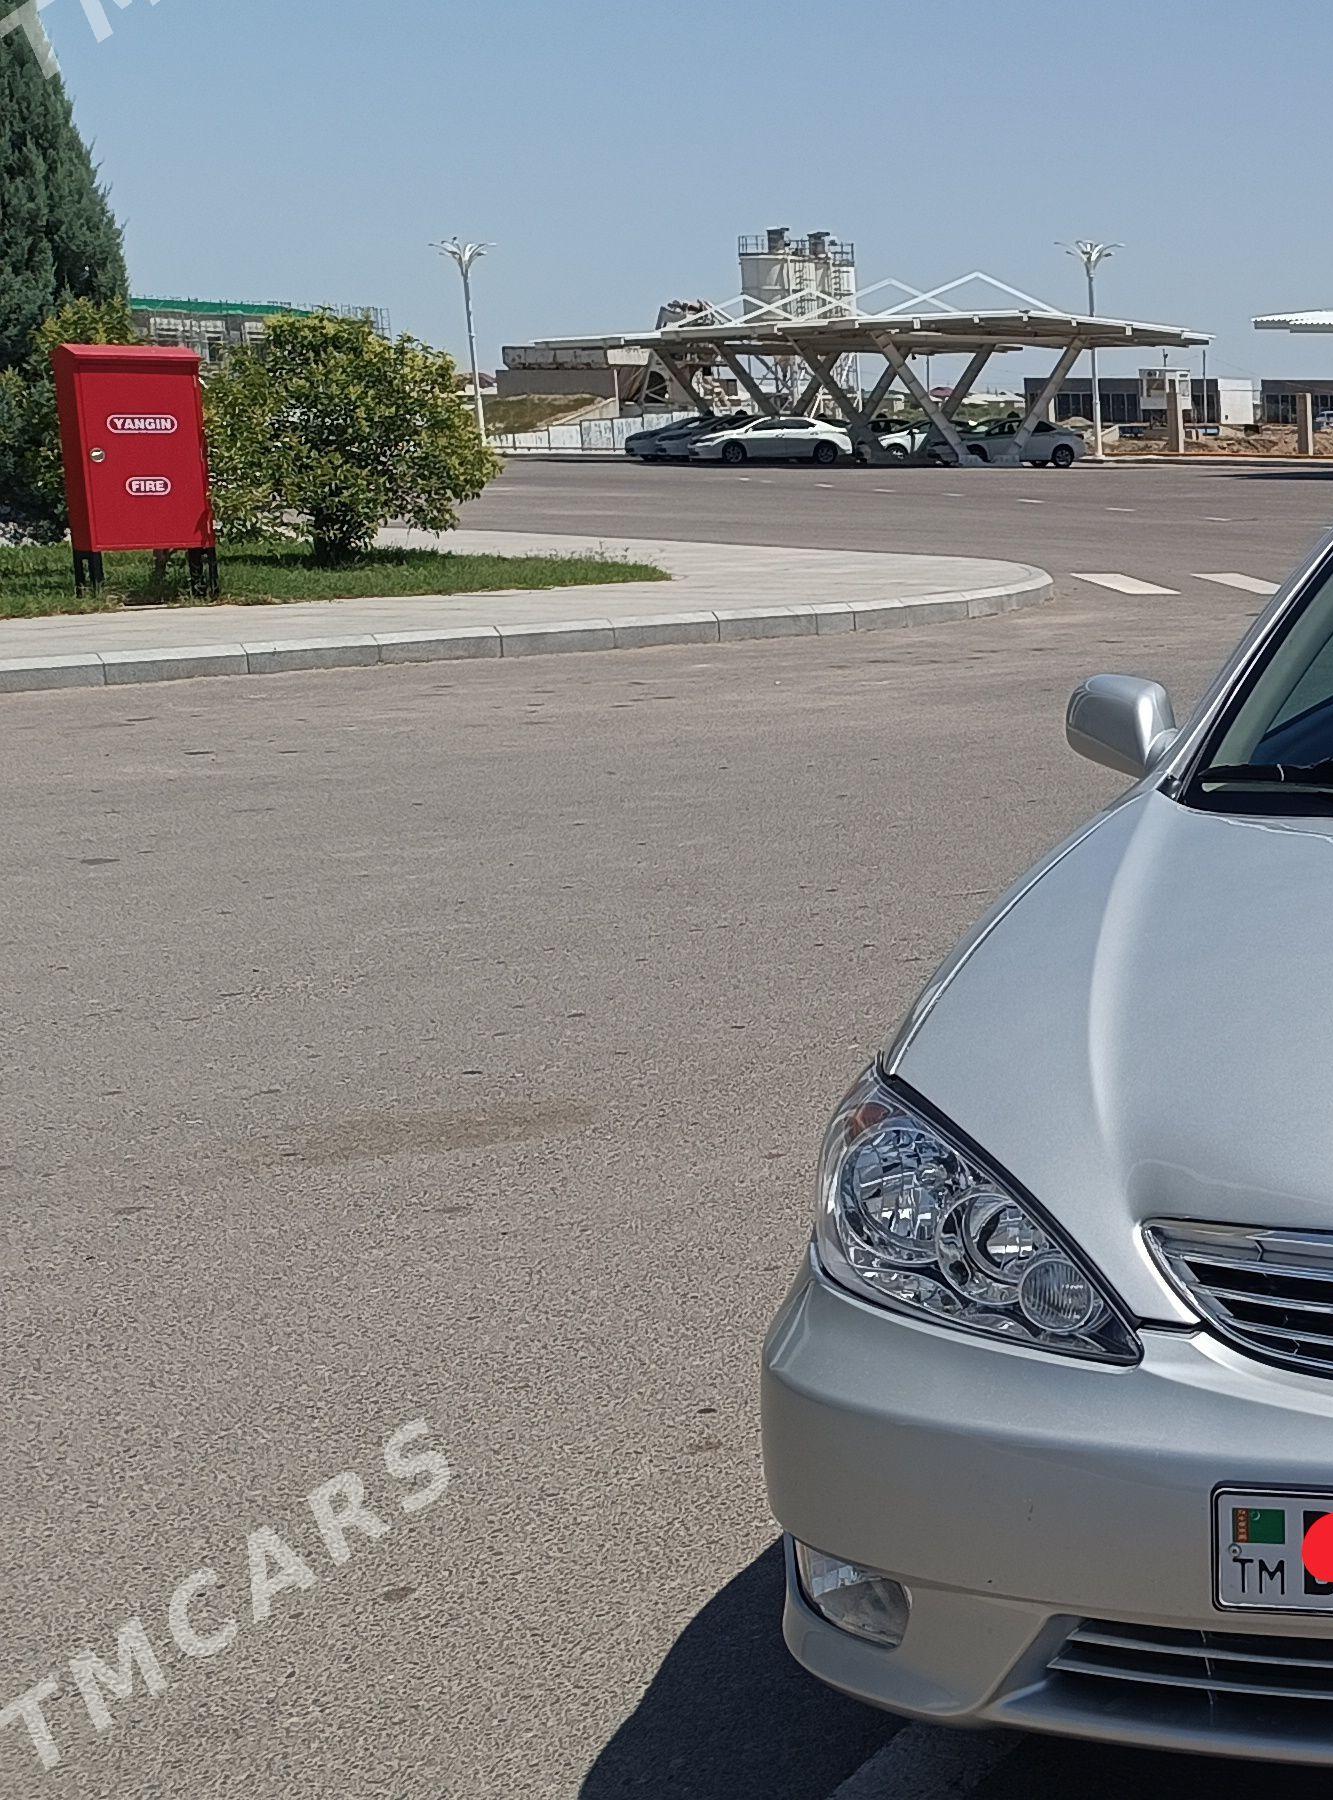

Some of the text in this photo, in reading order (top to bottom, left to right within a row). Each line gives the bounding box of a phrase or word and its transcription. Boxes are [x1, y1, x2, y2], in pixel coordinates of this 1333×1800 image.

[113, 418, 172, 430] YANGIN
[131, 480, 166, 492] FIRE
[1232, 1556, 1286, 1596] TM
